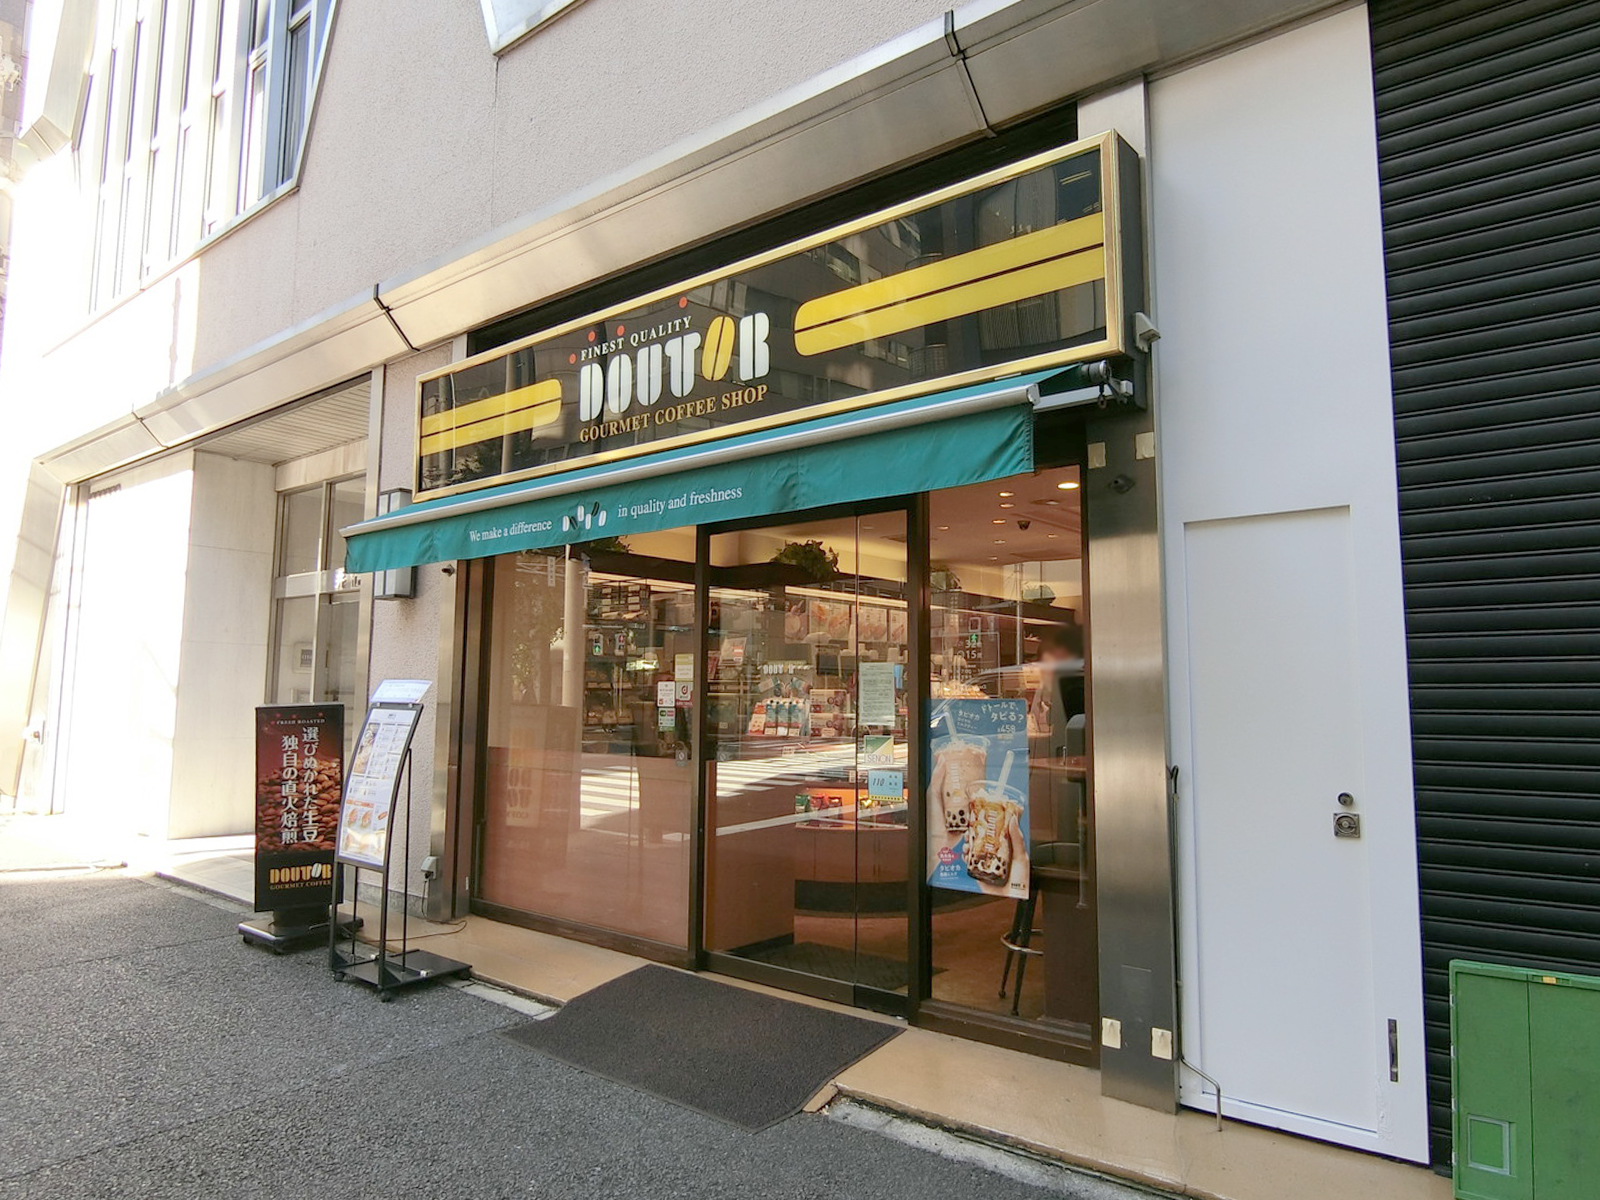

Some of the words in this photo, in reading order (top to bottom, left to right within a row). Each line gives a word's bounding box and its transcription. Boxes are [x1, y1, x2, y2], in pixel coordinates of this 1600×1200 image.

[579, 312, 770, 422] DOUTOR
[580, 337, 625, 361] FINEST
[630, 315, 692, 346] QUALITY
[579, 412, 650, 443] GOURMET
[654, 396, 716, 425] COFFEE
[721, 384, 768, 411] SHOP
[469, 531, 481, 543] We
[481, 527, 502, 540] make
[509, 519, 552, 535] difference
[617, 504, 628, 518] in
[630, 499, 666, 519] quality
[667, 496, 687, 511] and
[689, 487, 742, 506] freshness
[281, 734, 299, 845] 独自の直火焙煎
[302, 726, 320, 843] 選びぬかれた生豆
[269, 862, 332, 884] DOUTOR
